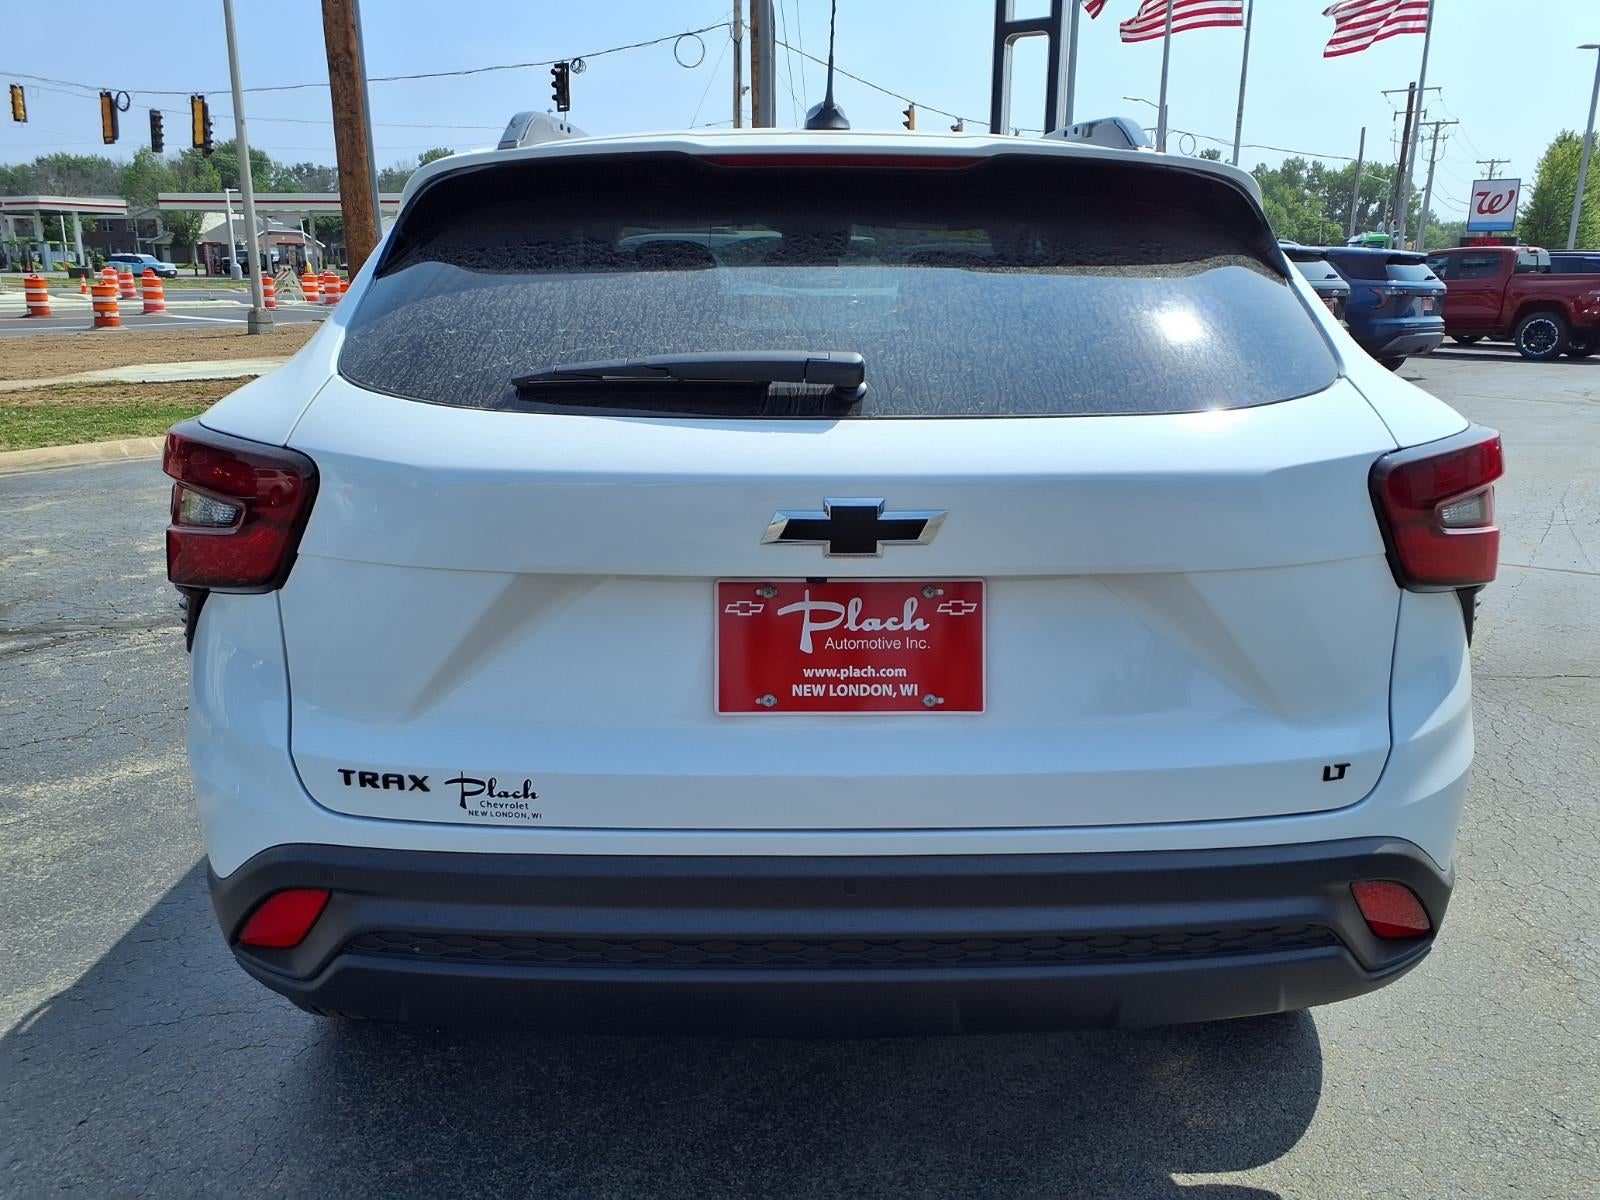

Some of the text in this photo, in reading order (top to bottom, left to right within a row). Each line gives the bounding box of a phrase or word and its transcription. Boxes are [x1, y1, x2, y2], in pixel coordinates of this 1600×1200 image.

[1475, 190, 1515, 214] W
[777, 589, 929, 654] Plach
[824, 636, 931, 650] Automotive Inc.
[803, 665, 907, 679] www.plach.com
[792, 684, 919, 699] NEW LONDON, WI
[337, 768, 431, 792] TRAX
[1322, 762, 1352, 782] LT
[444, 770, 540, 809] Plach
[479, 800, 529, 810] Chevrolet
[490, 811, 530, 820] LONDON,
